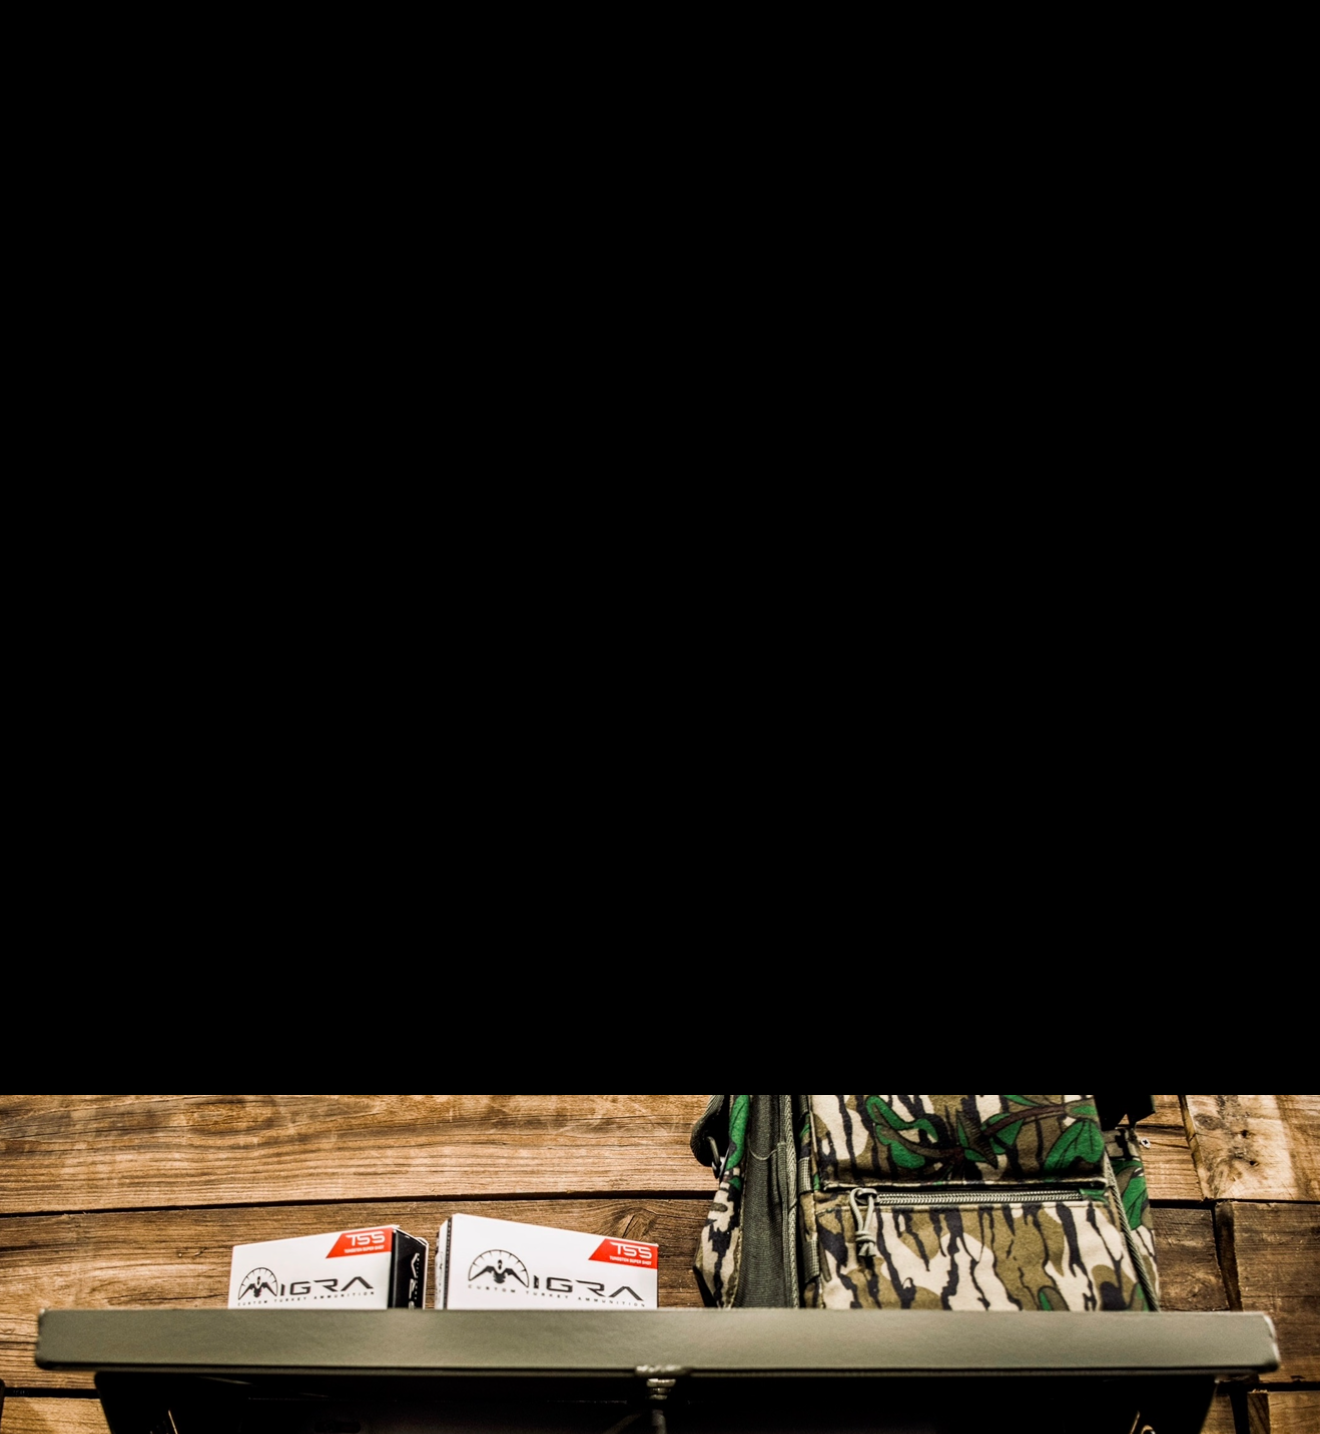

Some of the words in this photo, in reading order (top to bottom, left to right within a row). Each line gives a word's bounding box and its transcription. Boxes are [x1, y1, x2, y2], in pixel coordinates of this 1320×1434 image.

[345, 1231, 385, 1246] TSS
[609, 1241, 652, 1259] TSS
[468, 1284, 516, 1293] CUSTOM
[578, 1296, 645, 1307] AMMUNITION
